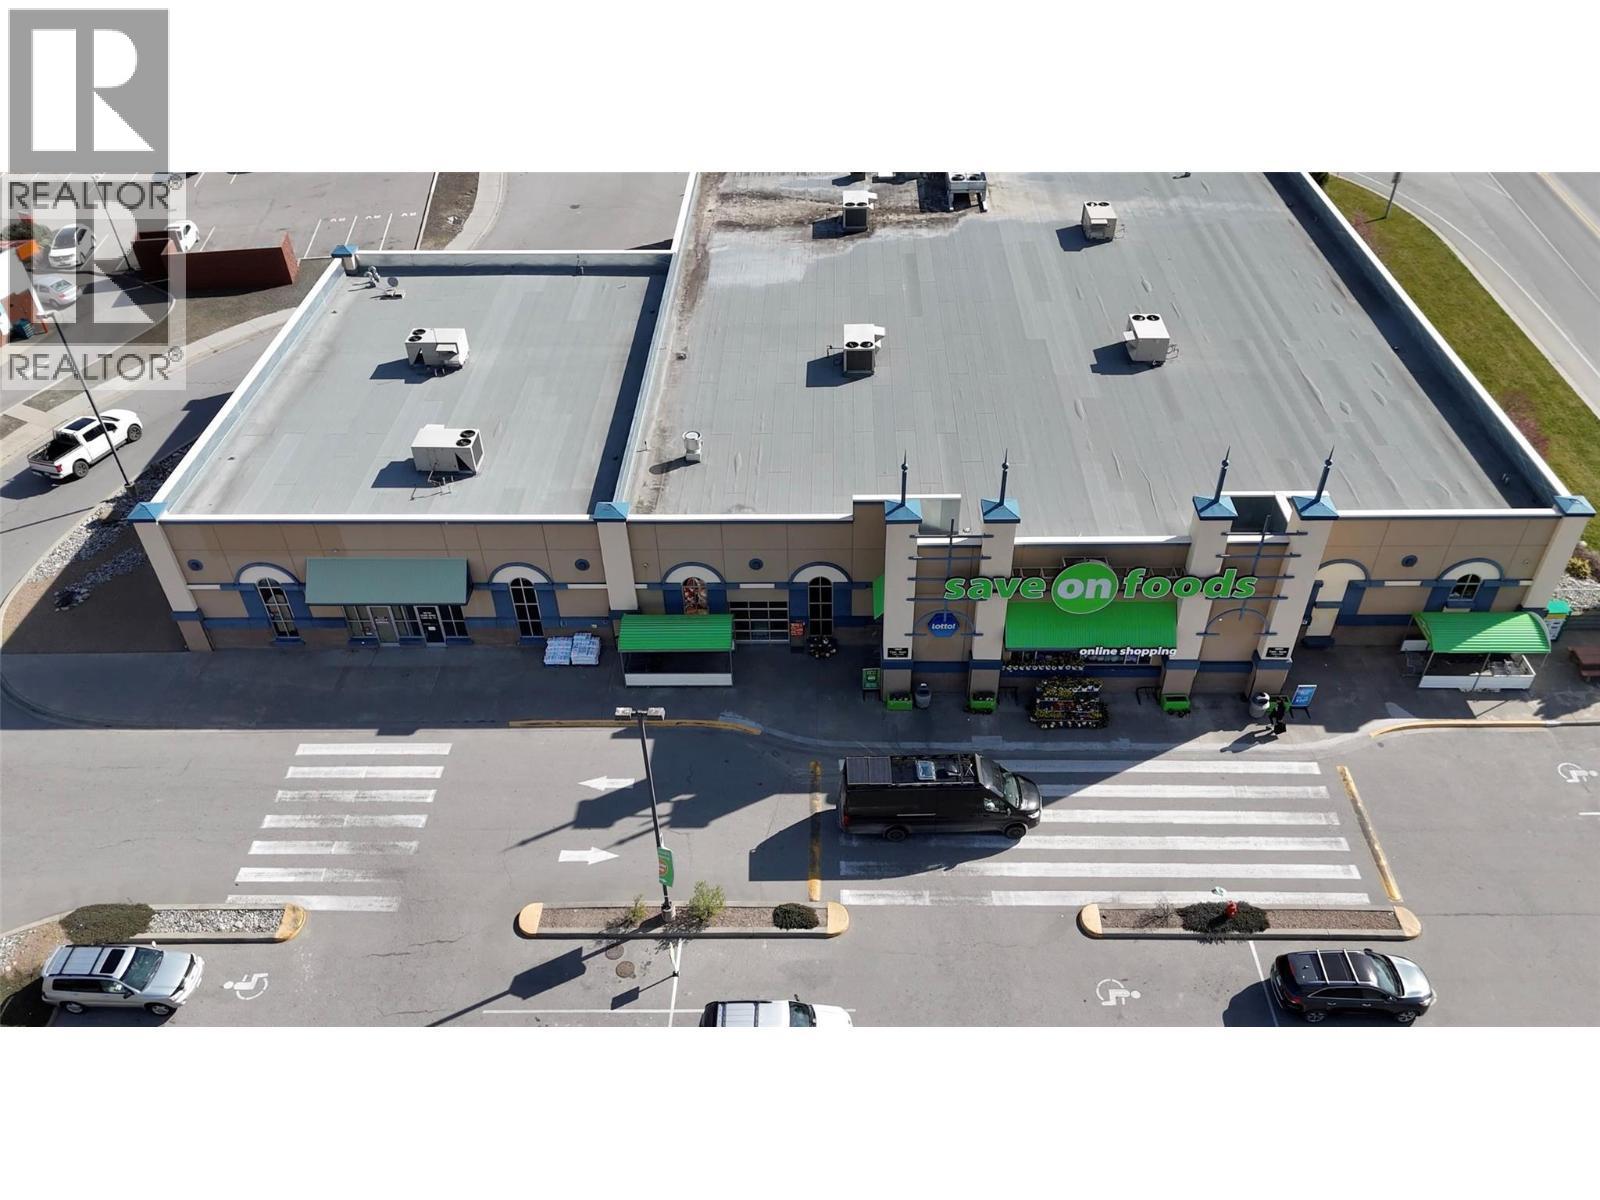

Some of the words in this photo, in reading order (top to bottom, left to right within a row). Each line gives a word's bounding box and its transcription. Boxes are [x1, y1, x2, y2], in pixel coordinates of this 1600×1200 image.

[943, 576, 1047, 600] save
[1057, 578, 1112, 600] on
[1123, 567, 1258, 599] foods
[1079, 646, 1118, 656] online
[1119, 646, 1178, 657] shopping
